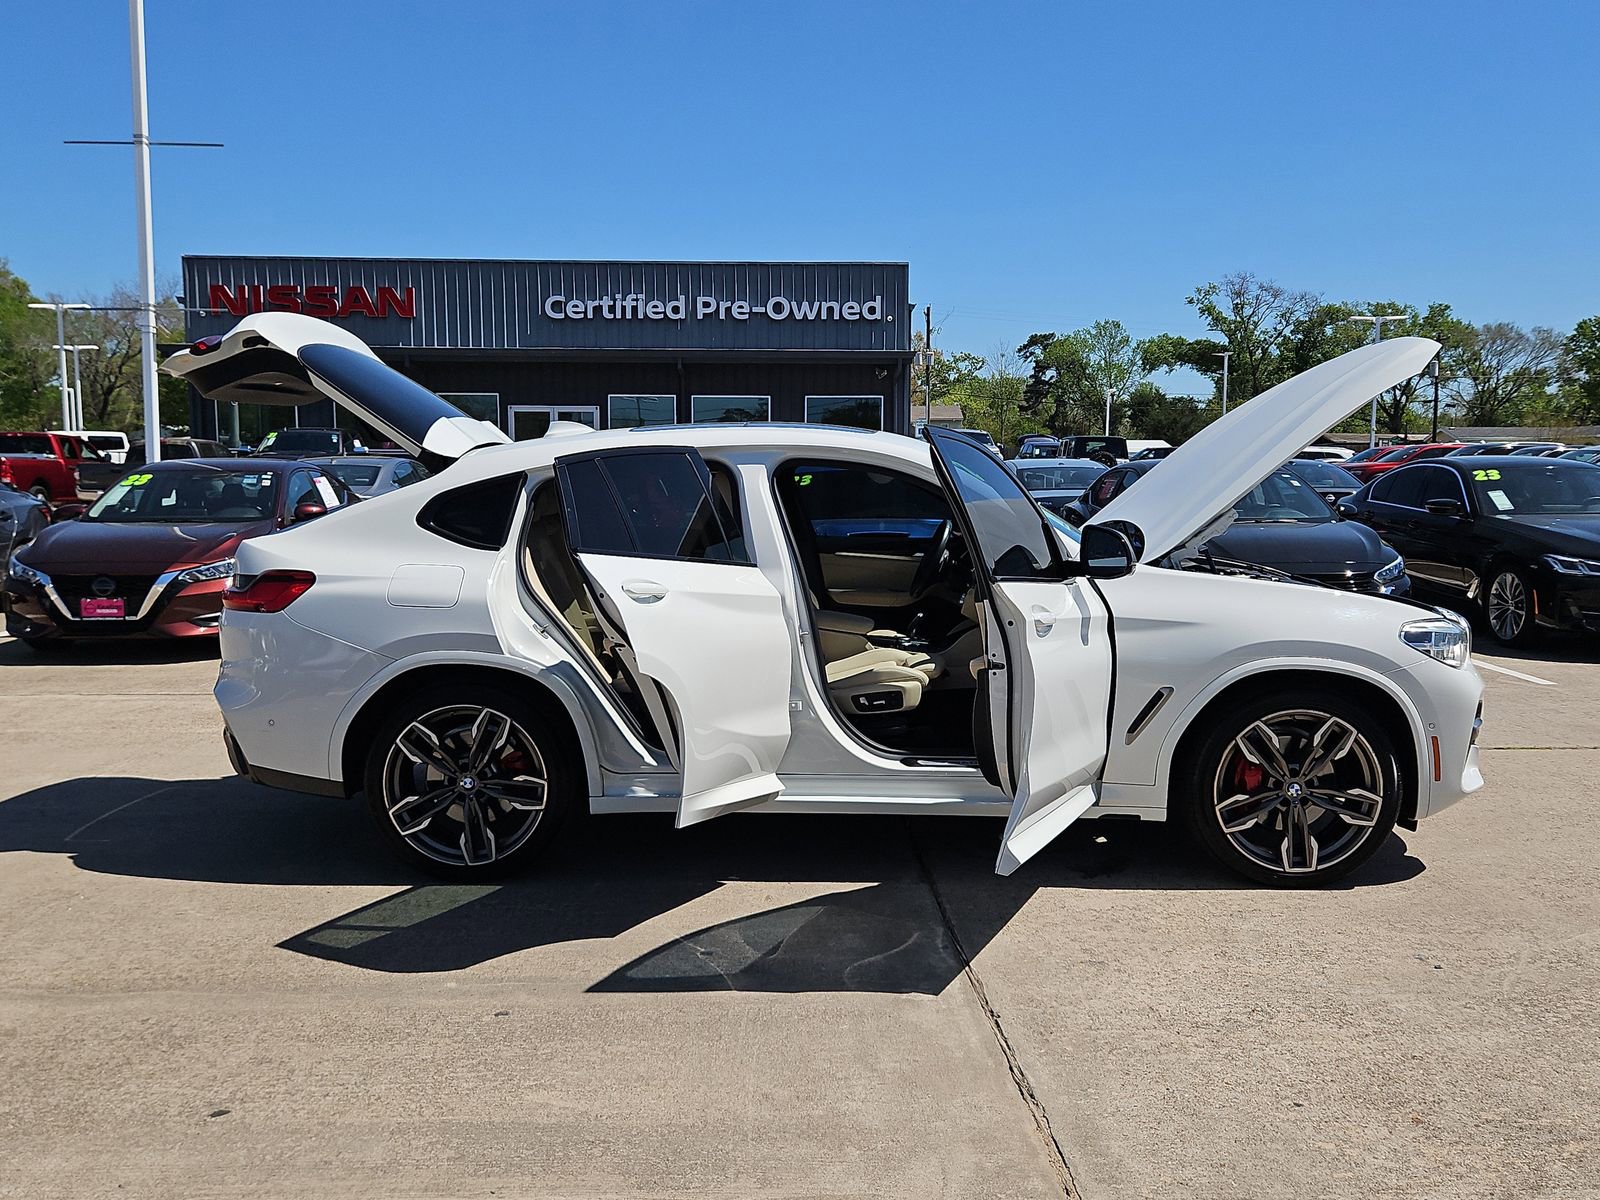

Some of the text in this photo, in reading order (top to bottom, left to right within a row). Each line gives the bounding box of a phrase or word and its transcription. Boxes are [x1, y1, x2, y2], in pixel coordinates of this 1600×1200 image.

[209, 284, 416, 318] NISSAN
[544, 293, 882, 321] Certified Pre-Owned
[120, 474, 154, 486] 23
[1472, 469, 1501, 480] 23
